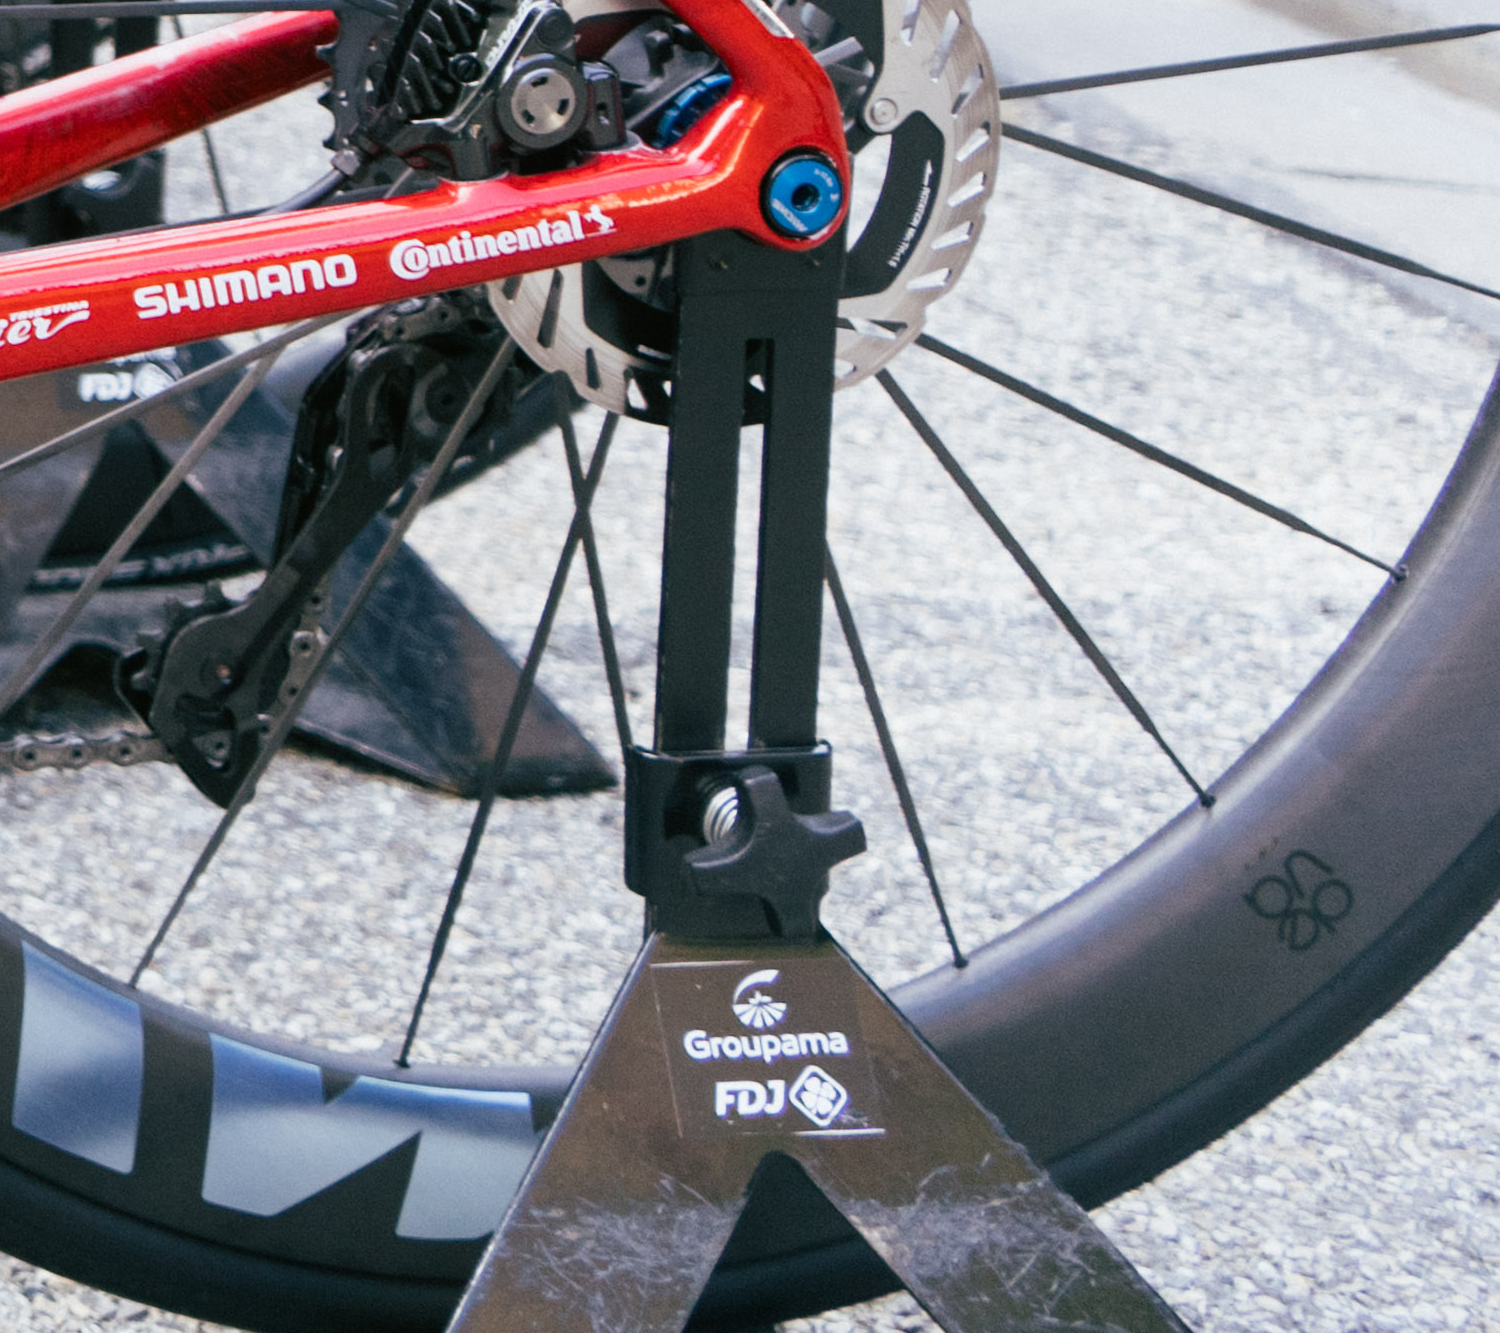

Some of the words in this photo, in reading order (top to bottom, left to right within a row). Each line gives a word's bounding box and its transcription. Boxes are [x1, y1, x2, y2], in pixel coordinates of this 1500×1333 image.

[389, 210, 588, 282] Continental
[133, 253, 359, 320] SHIMANO
[7, 299, 91, 323] TRIESTINA
[682, 1029, 849, 1065] Groupama
[714, 1079, 786, 1118] FDJ
